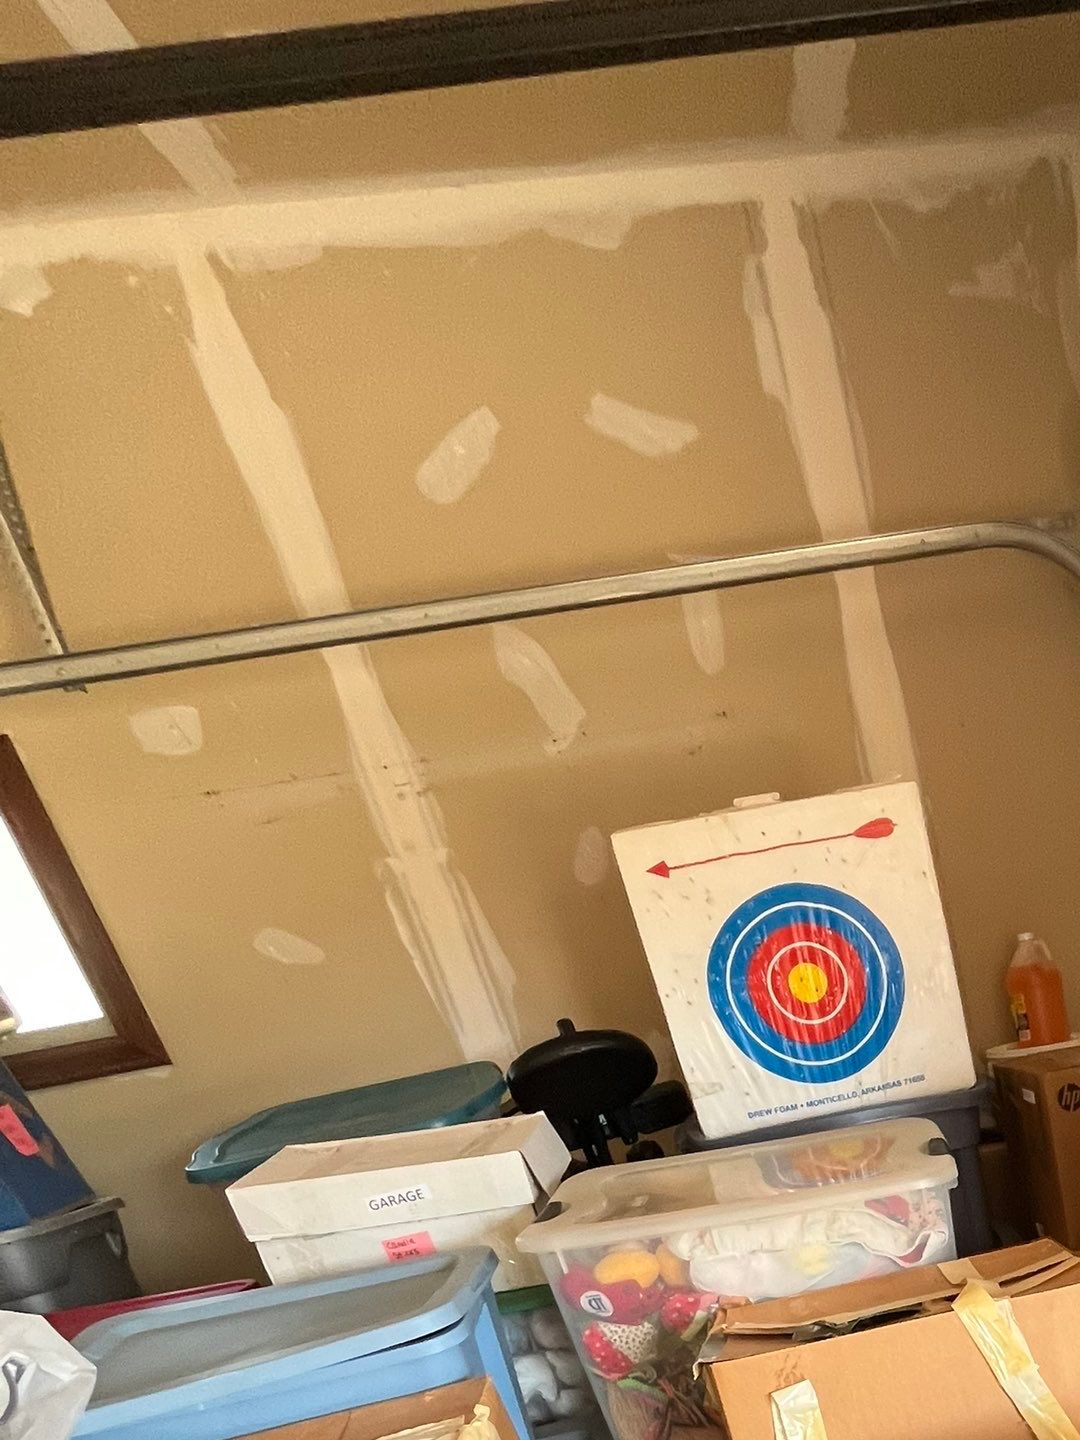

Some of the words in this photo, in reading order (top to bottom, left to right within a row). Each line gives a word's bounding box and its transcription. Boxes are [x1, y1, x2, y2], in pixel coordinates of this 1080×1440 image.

[748, 1108, 773, 1119] DREW
[774, 1104, 799, 1115] FOAM
[861, 1079, 902, 1096] ARKANSAS
[368, 1188, 425, 1211] GARAGE
